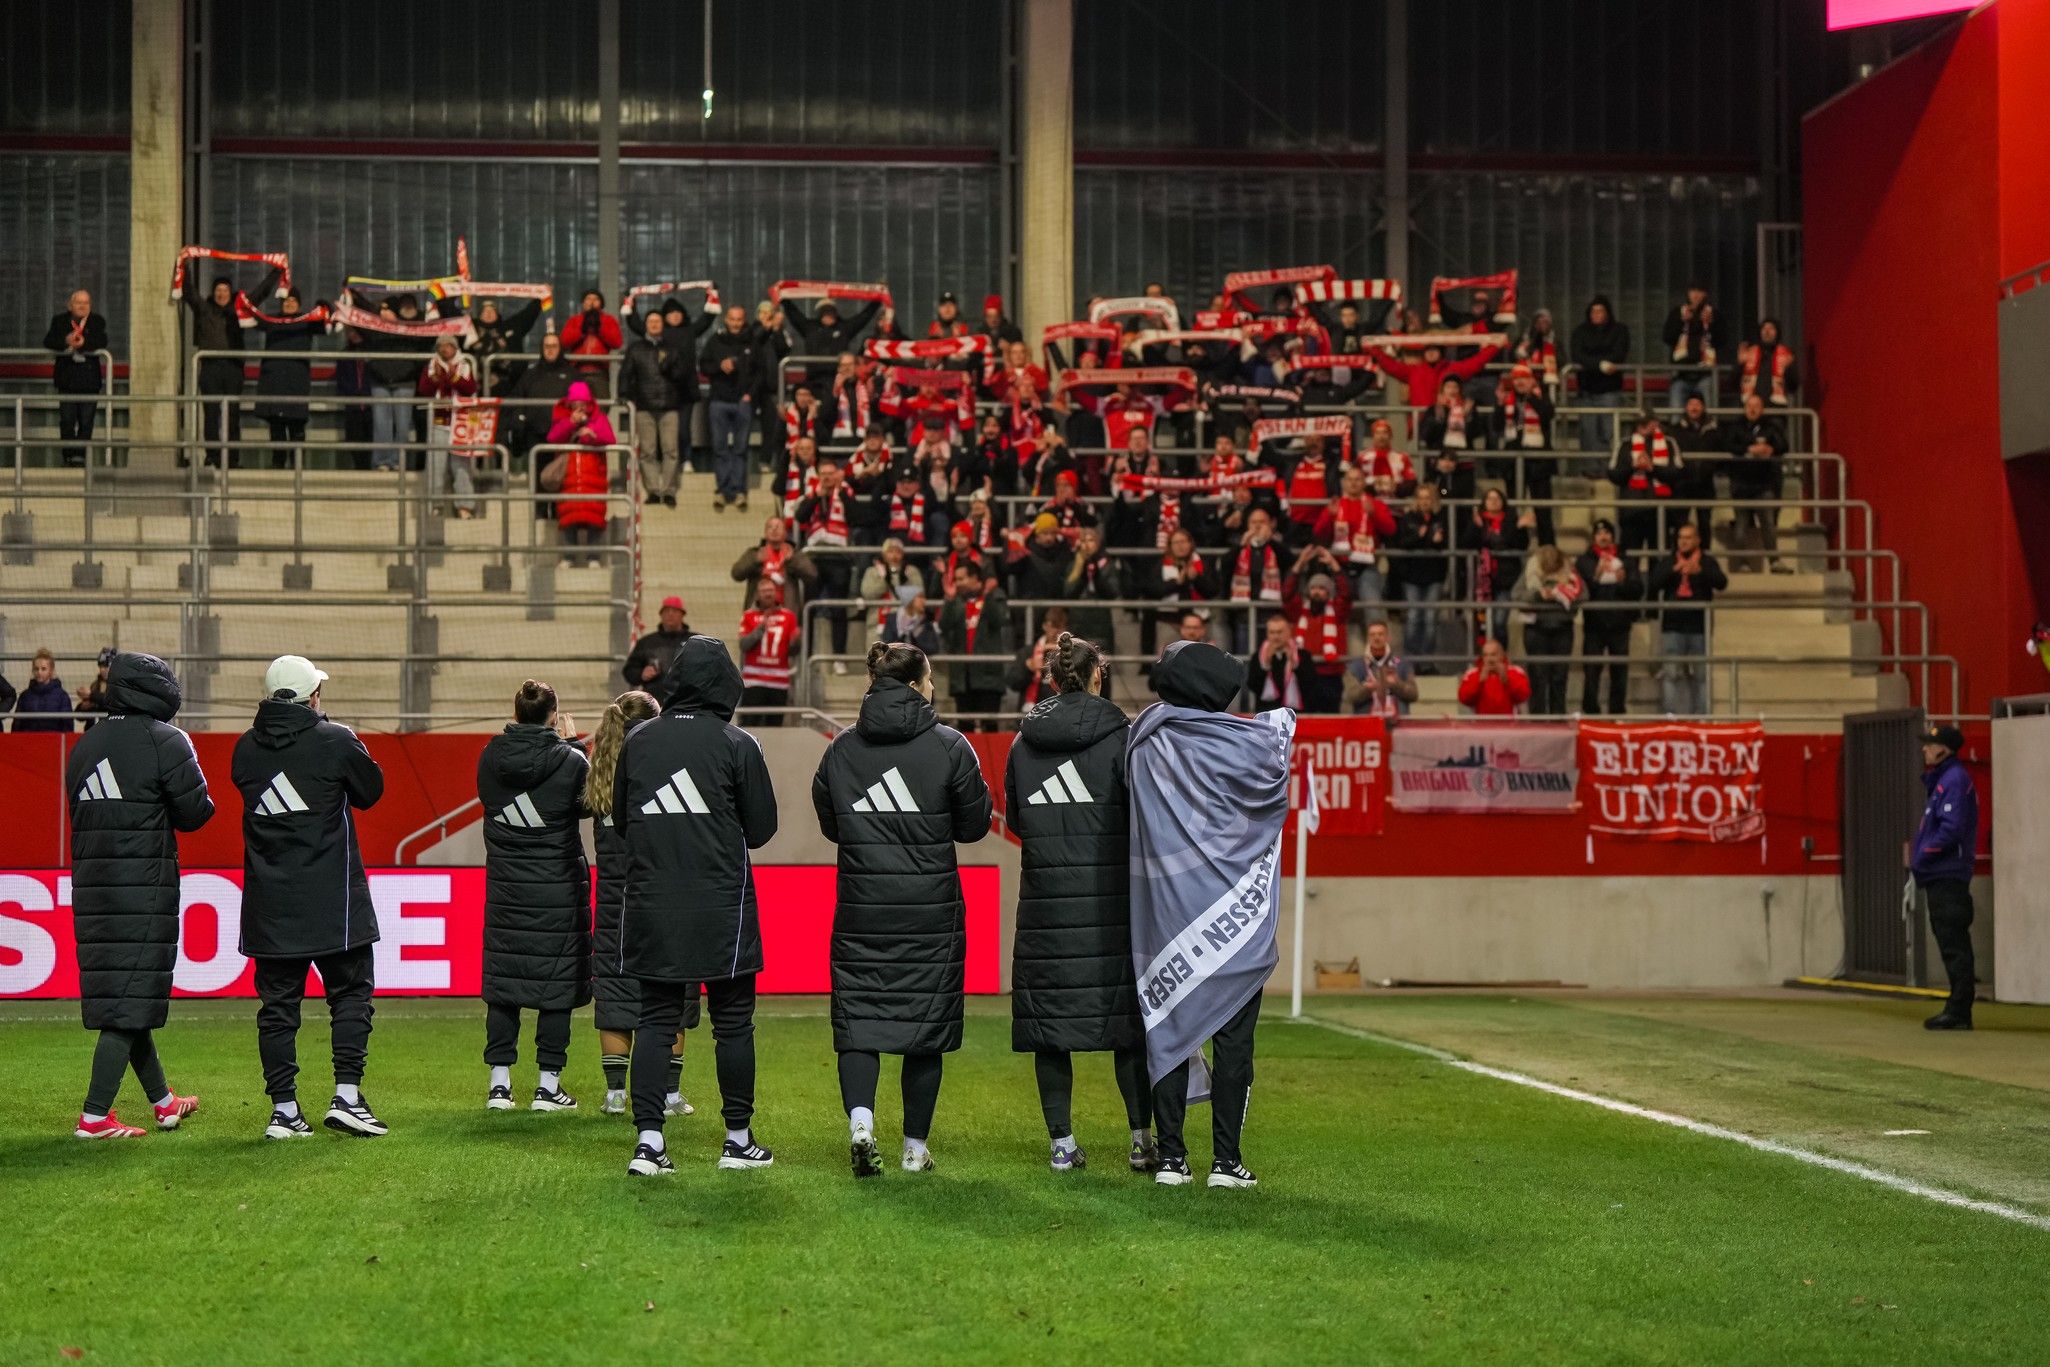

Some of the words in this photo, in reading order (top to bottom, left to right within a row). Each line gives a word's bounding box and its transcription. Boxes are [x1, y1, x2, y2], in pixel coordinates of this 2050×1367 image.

[761, 627, 784, 656] 17
[1590, 734, 1764, 776] EISERN
[1400, 771, 1471, 792] BRIGADE
[1507, 772, 1572, 791] BAVARIA
[1595, 776, 1762, 823] UNION
